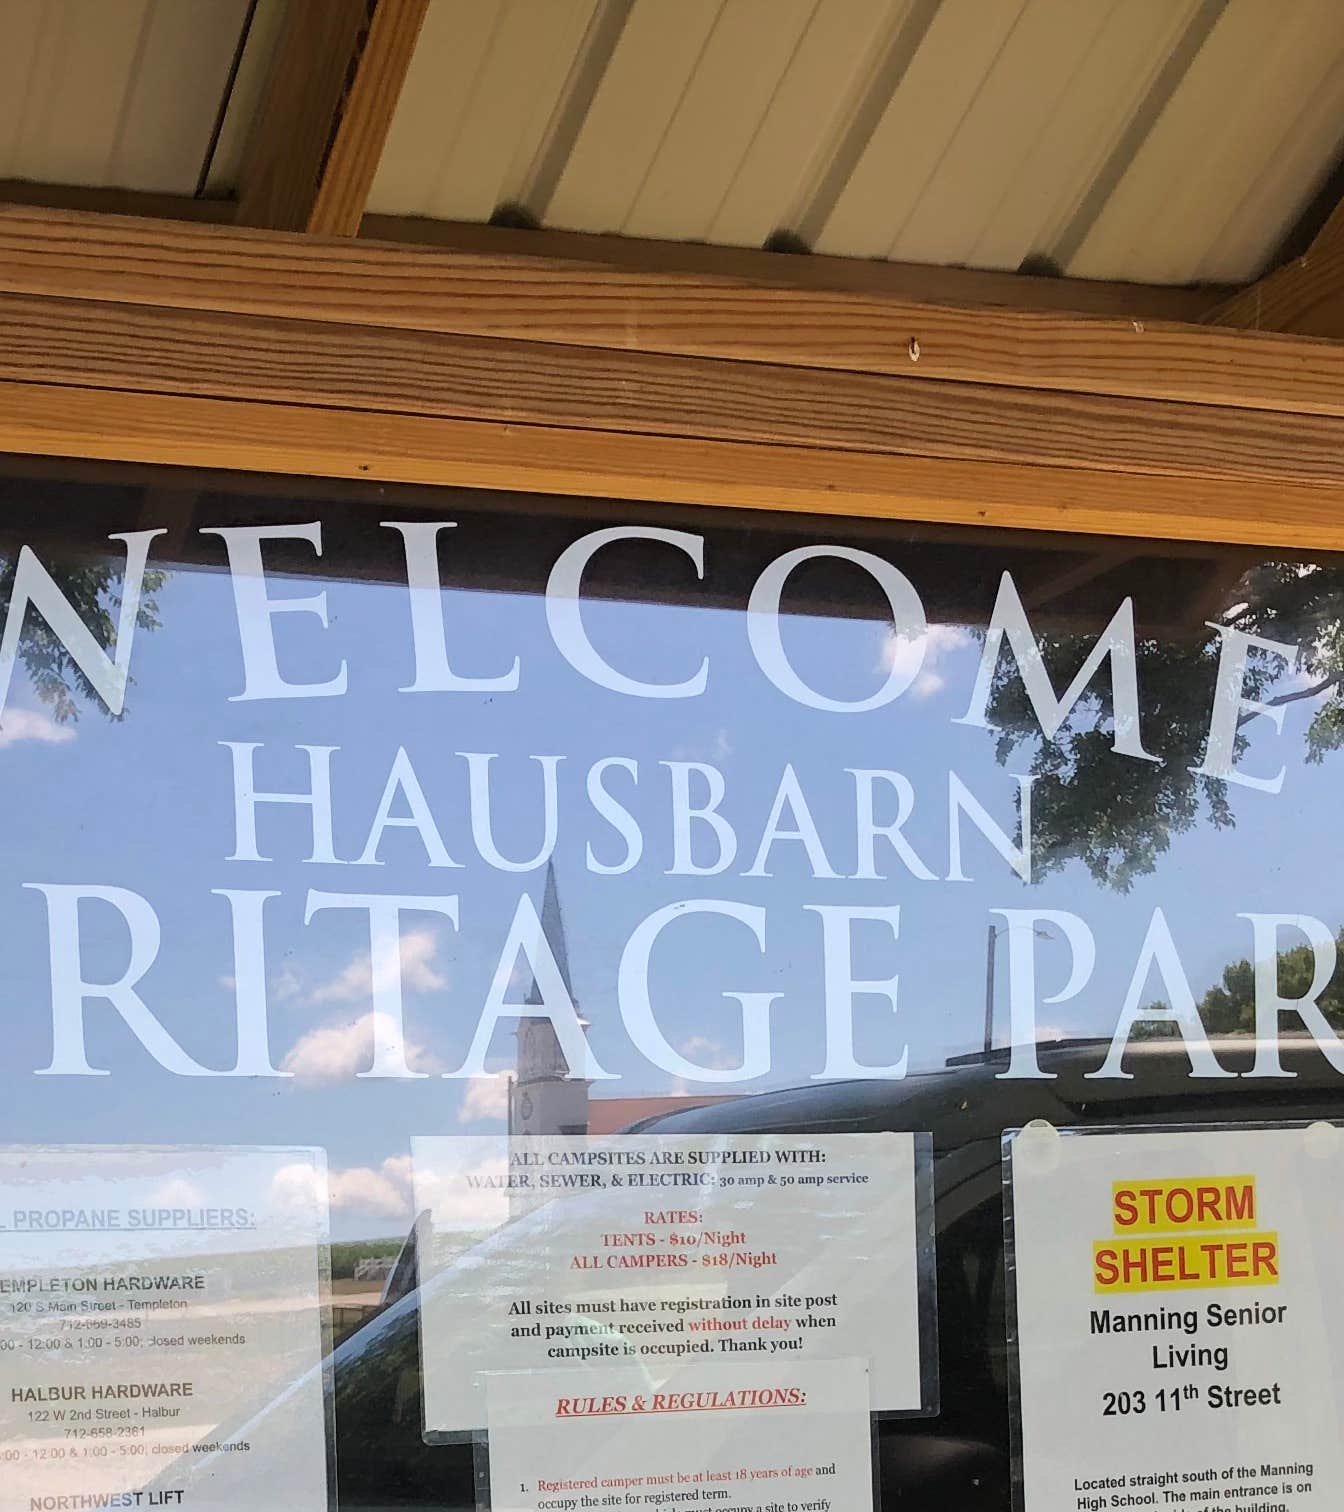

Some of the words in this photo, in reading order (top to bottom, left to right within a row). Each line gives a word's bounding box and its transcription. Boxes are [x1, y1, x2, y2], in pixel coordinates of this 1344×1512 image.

[218, 741, 1037, 885] HAUSBARN
[511, 1152, 544, 1166] ALL
[547, 1151, 646, 1165] CAMPSITES
[649, 1151, 684, 1165] ARE
[687, 1150, 771, 1164] SUPPLIED
[774, 1149, 826, 1164] WITH:
[539, 1173, 607, 1189] SEWER,
[610, 1173, 623, 1187] &
[627, 1172, 715, 1187] ELECTRIC:
[719, 1175, 736, 1187] 30
[738, 1176, 765, 1187] amp
[767, 1174, 777, 1185] &
[779, 1174, 795, 1187] 50
[797, 1175, 824, 1187] amp
[827, 1172, 869, 1185] service
[1114, 1184, 1254, 1226] STORM
[13, 1209, 120, 1229] PROPANE
[127, 1207, 258, 1228] SUPPLIERS:
[644, 1210, 702, 1224] RATES:
[600, 1232, 656, 1247] TENTS
[669, 1230, 746, 1248] $10/Night
[572, 1255, 603, 1269] ALL
[606, 1253, 688, 1268] CAMPERS
[1095, 1241, 1278, 1286] SHELTER
[103, 1275, 205, 1291] HARDWARE
[508, 1300, 531, 1315] All
[535, 1300, 572, 1314] sites
[576, 1300, 616, 1313] must
[620, 1298, 656, 1312] have
[660, 1295, 752, 1314] registration
[755, 1294, 770, 1308] in
[774, 1293, 802, 1307] site
[804, 1293, 838, 1310] post
[510, 1322, 541, 1337] and
[545, 1322, 615, 1340] payment
[618, 1318, 684, 1334] received
[688, 1317, 748, 1331] without
[751, 1315, 791, 1331] delay
[795, 1313, 836, 1328] when
[1090, 1307, 1197, 1335] Manning
[1206, 1301, 1287, 1327] Senior
[547, 1342, 619, 1360] campsite
[623, 1342, 636, 1355] is
[640, 1338, 714, 1357] occupied.
[717, 1336, 767, 1352] Thank
[770, 1336, 803, 1353] you!
[1152, 1343, 1228, 1371] Living
[11, 1386, 86, 1402] HALBUR
[91, 1382, 193, 1399] HARDWARE
[555, 1395, 627, 1415] RULES
[631, 1395, 647, 1411] &
[651, 1387, 806, 1410] REGULATIONS:
[1102, 1390, 1146, 1416] 203
[1207, 1382, 1281, 1408] Street
[28, 1409, 49, 1422] 122
[52, 1409, 66, 1421] W
[69, 1408, 91, 1421] 2nd
[95, 1408, 131, 1420] Street
[141, 1406, 180, 1418] Halbur
[1074, 1475, 1125, 1491] Located
[1129, 1471, 1178, 1488] straight
[1181, 1468, 1217, 1483] south
[1221, 1466, 1234, 1480] of
[1236, 1466, 1256, 1478] the
[1260, 1462, 1313, 1477] Manning
[30, 1491, 144, 1511] NORTHWEST
[148, 1489, 184, 1505] LIFT
[1077, 1495, 1107, 1512] High
[1110, 1491, 1158, 1507] School.
[1162, 1490, 1186, 1503] The
[1189, 1487, 1220, 1501] main
[1223, 1485, 1278, 1499] entrance
[1282, 1482, 1292, 1494] is
[1296, 1482, 1312, 1493] on
